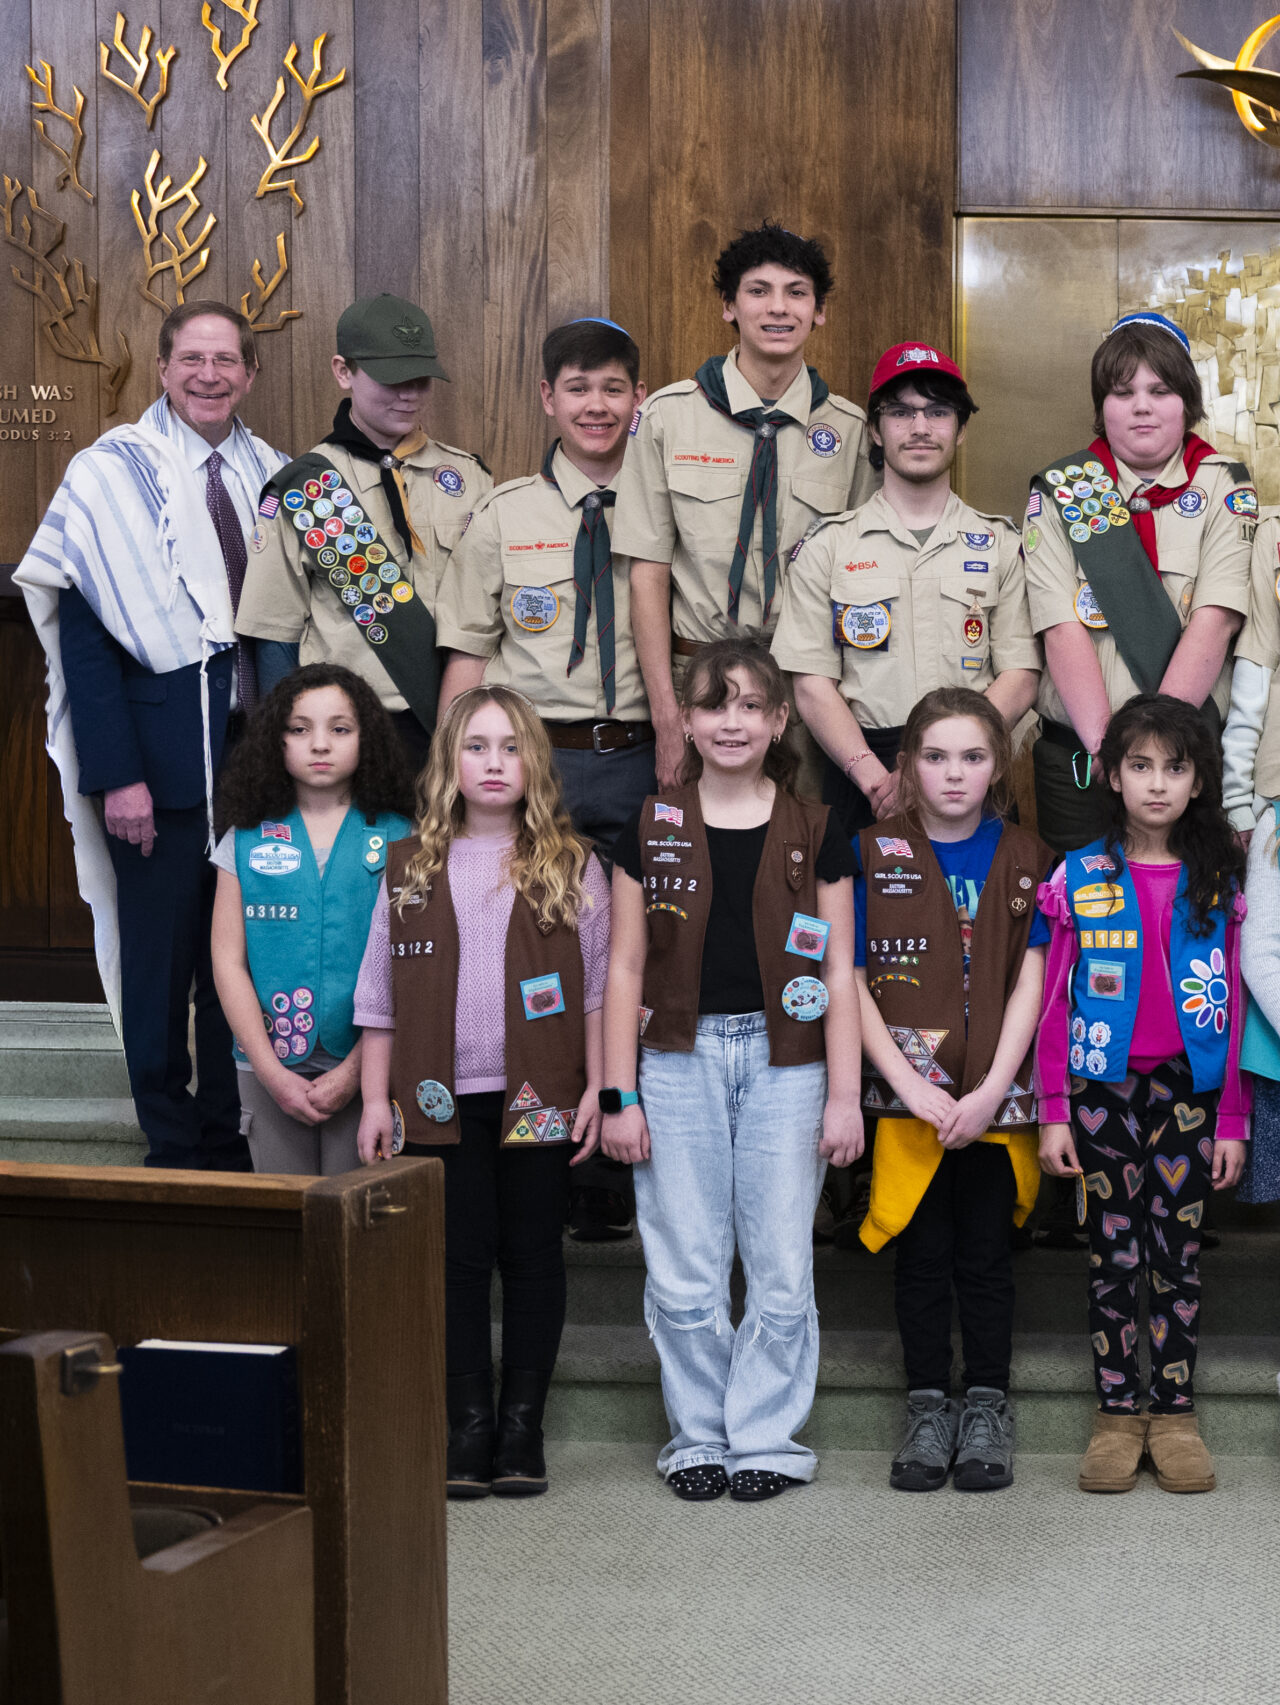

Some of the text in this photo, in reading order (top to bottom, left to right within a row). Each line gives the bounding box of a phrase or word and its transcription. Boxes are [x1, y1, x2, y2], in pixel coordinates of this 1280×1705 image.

[30, 385, 74, 401] WAS
[0, 408, 57, 424] UMED
[0, 429, 40, 441] ODUS
[858, 560, 879, 570] BSA
[265, 852, 287, 860] SCOUTS
[246, 905, 298, 919] 63122
[870, 937, 927, 953] 63122
[1084, 932, 1136, 945] 3122
